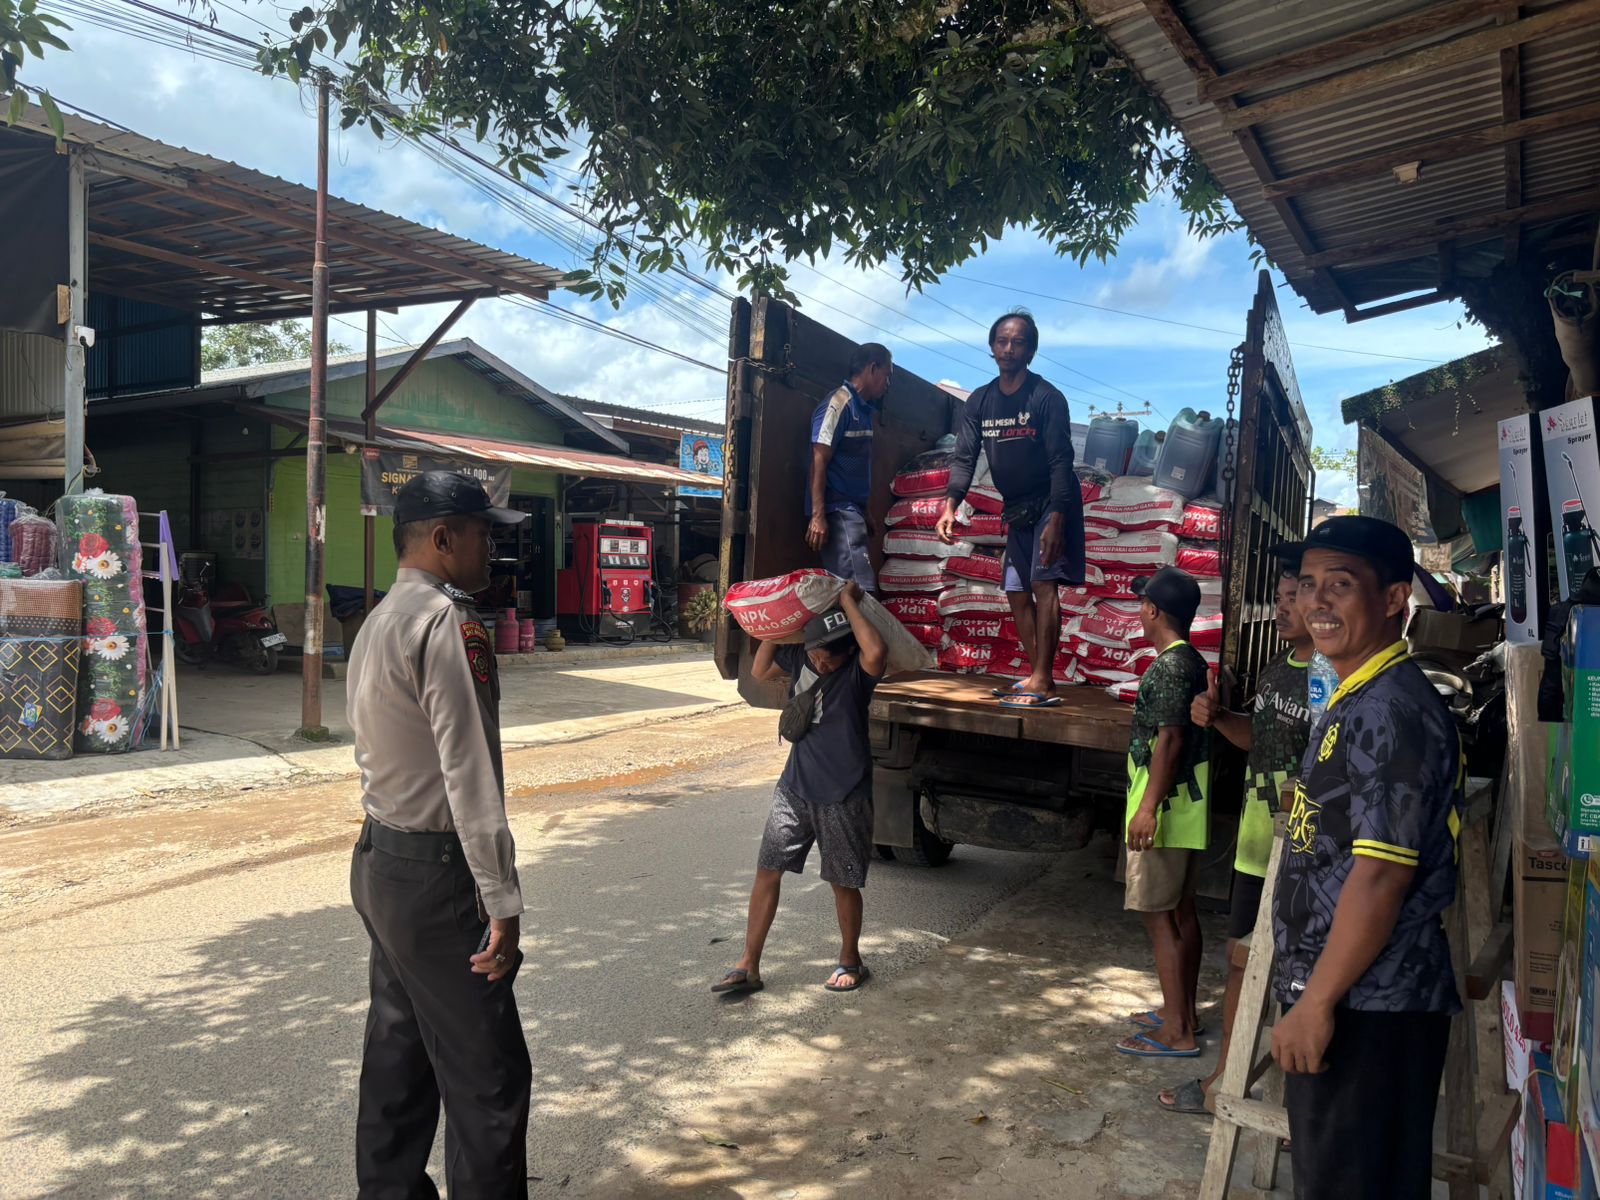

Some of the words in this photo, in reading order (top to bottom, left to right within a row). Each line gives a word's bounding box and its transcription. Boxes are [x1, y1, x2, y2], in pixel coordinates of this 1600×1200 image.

[995, 418, 1016, 427] MESIN
[1557, 410, 1588, 428] Scarlet
[1567, 433, 1592, 445] Sprayer
[911, 505, 937, 514] NPK
[1195, 521, 1218, 533] PK
[898, 604, 927, 615] NPK
[739, 608, 771, 624] NPK
[966, 626, 999, 637] NPK
[1527, 628, 1535, 638] 8L
[960, 647, 991, 660] NPK
[1268, 691, 1310, 722] Avian
